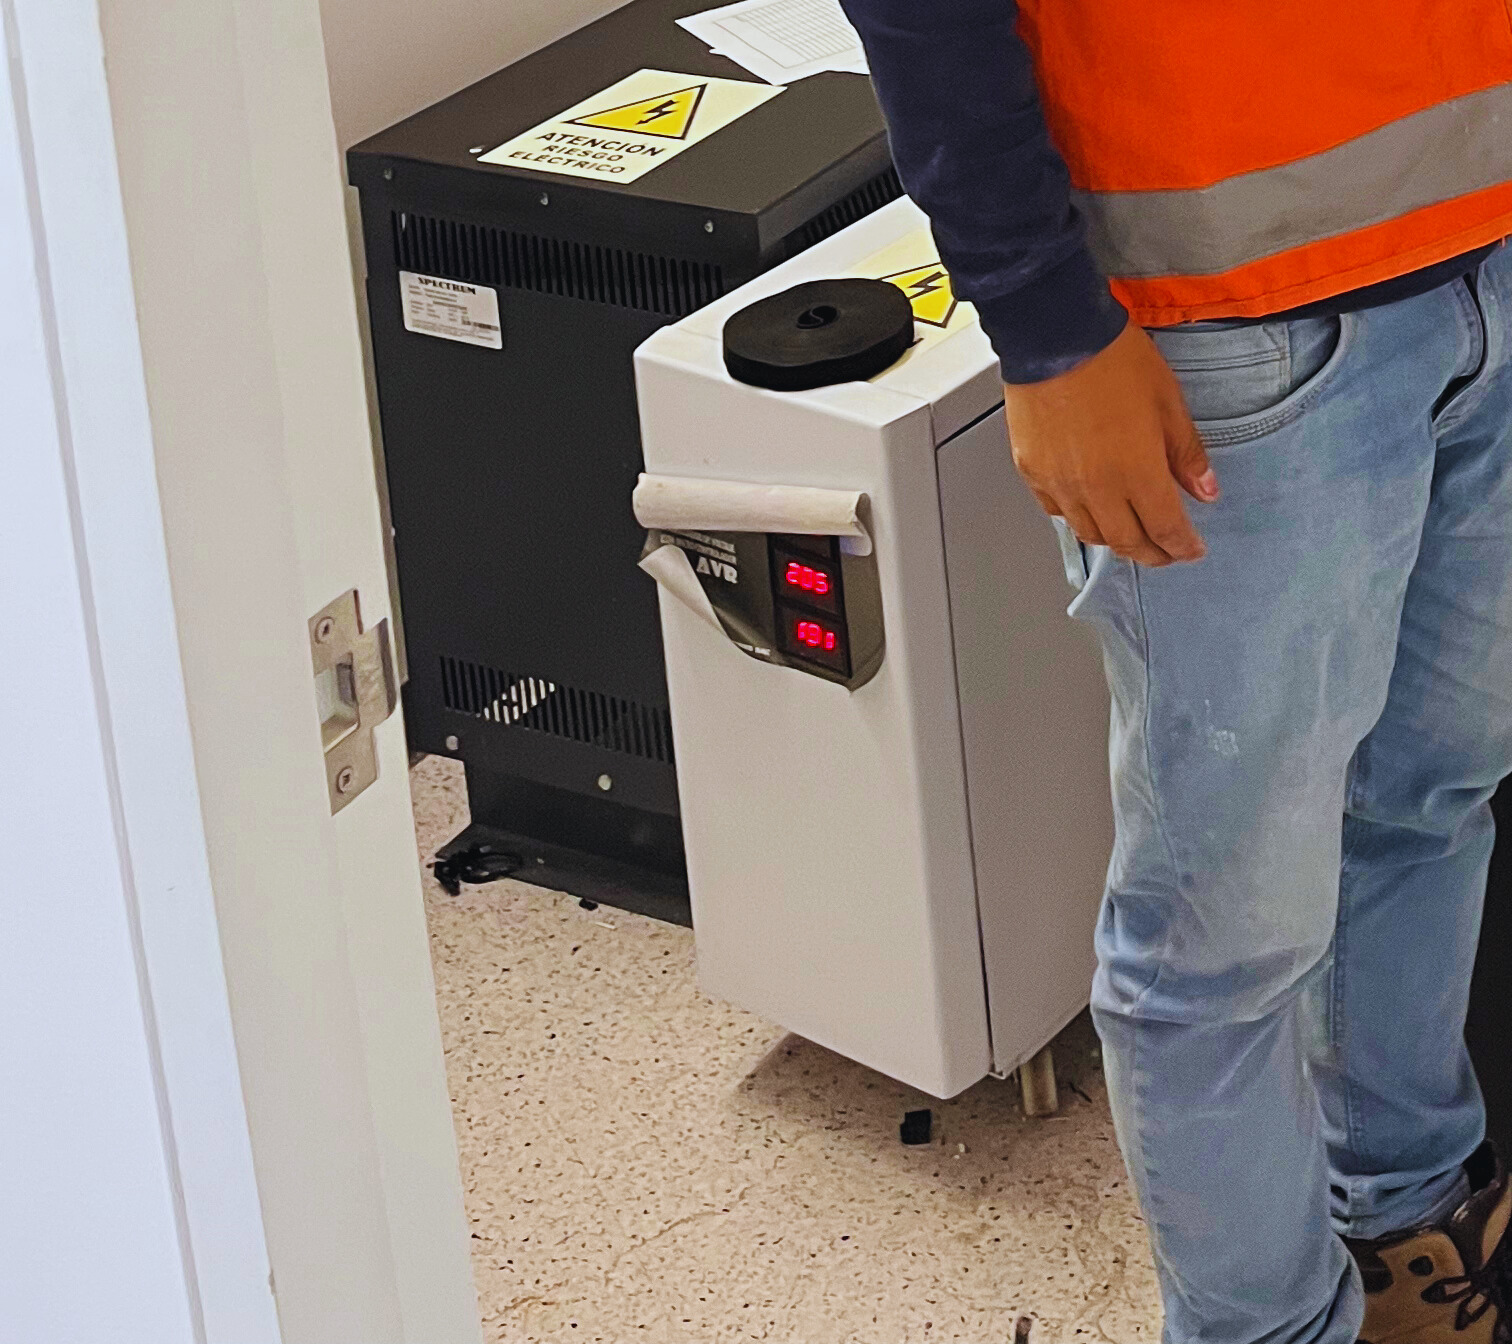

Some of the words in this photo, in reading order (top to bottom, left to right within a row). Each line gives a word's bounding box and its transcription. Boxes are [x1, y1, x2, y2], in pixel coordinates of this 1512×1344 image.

[535, 132, 667, 157] ATENCIÓN
[542, 144, 624, 162] RIESGO
[418, 276, 477, 296] SPECTRUM
